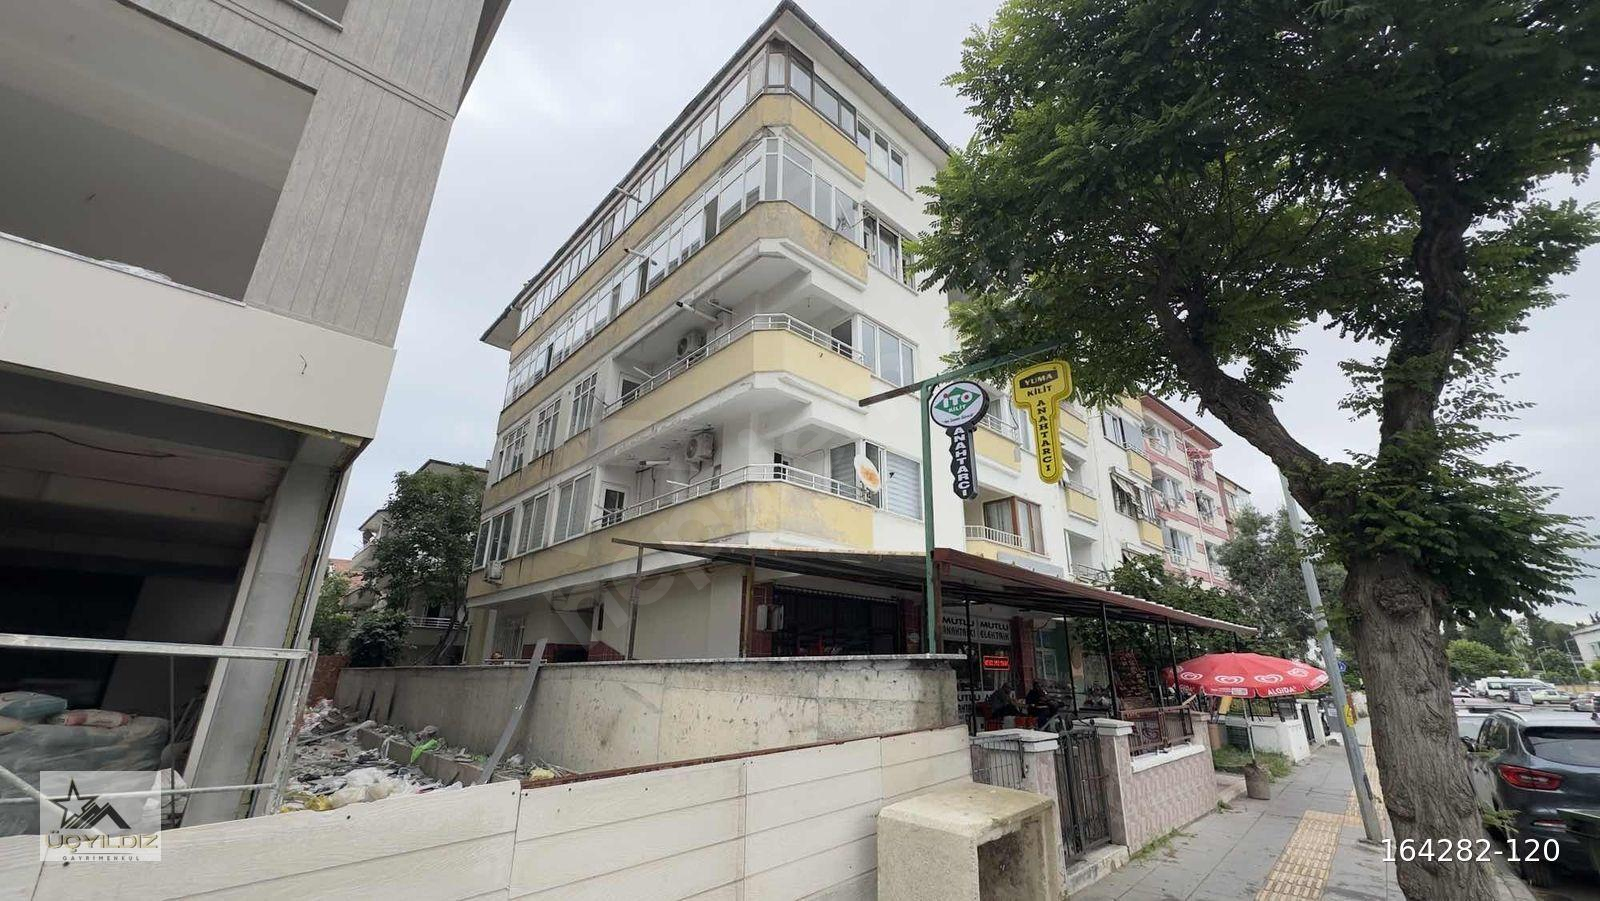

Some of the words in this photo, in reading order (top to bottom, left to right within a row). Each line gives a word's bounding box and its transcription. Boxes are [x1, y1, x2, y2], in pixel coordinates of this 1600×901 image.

[1023, 373, 1053, 387] YUMA
[1036, 400, 1053, 472] ANAHTARCI
[953, 427, 971, 497] ANAHTARCI
[942, 616, 975, 626] MUTLU
[980, 621, 1009, 630] MUTLU
